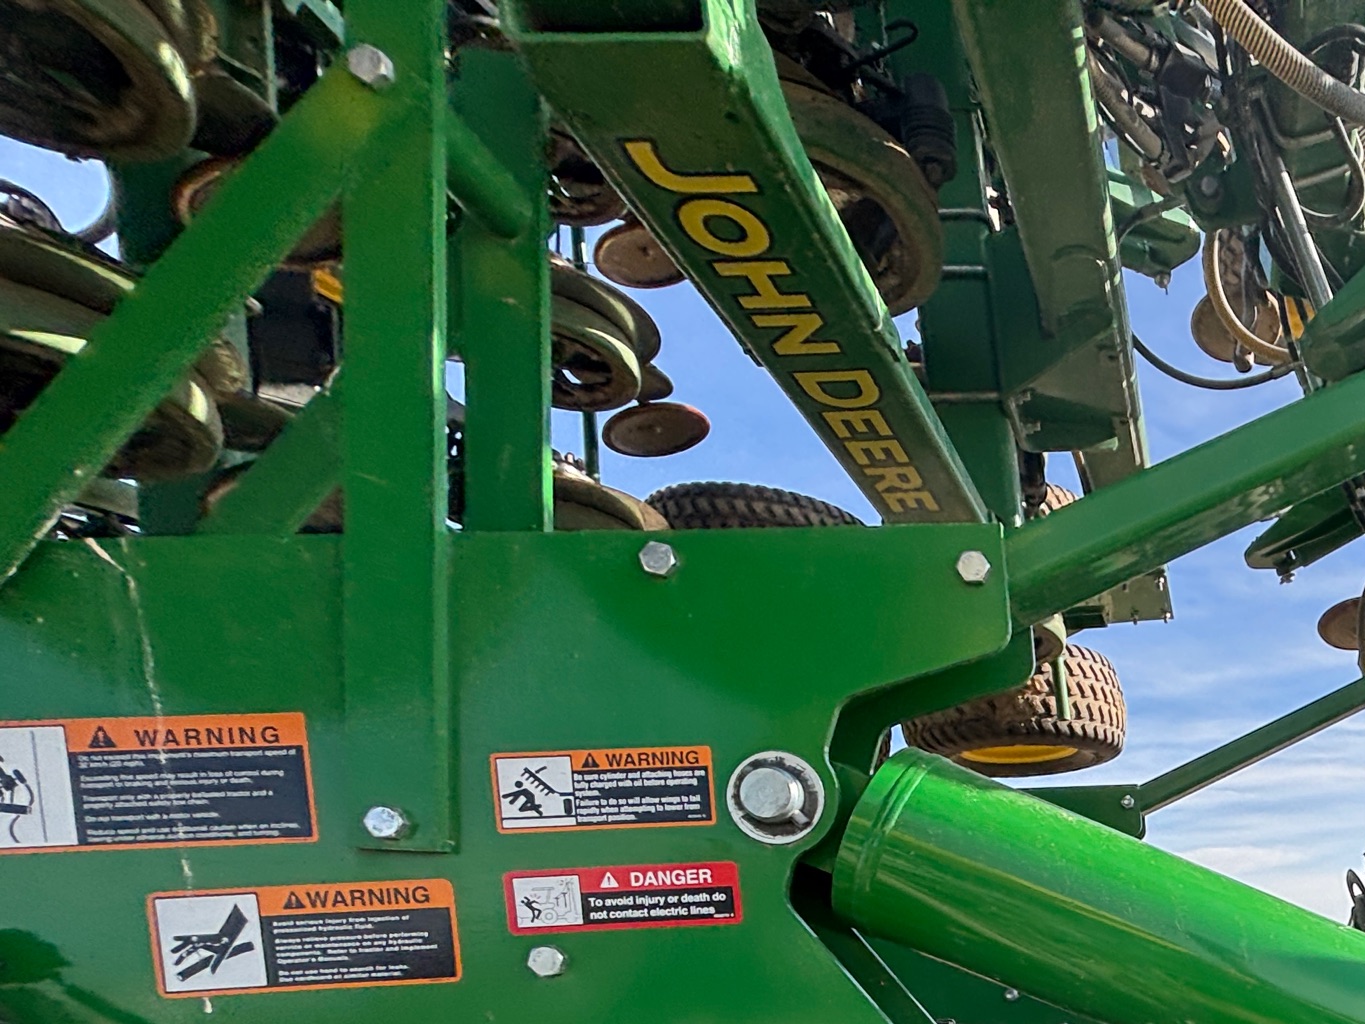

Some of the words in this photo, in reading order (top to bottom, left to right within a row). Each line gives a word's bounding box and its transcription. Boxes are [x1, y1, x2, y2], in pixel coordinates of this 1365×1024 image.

[624, 141, 841, 355] JOHN
[792, 370, 940, 513] DEERE
[134, 726, 281, 747] WARNING
[605, 751, 699, 767] WARNING
[630, 869, 712, 886] DANGER
[306, 886, 430, 908] WARNING
[588, 898, 602, 907] To
[605, 896, 633, 906] avoid
[635, 895, 665, 906] injury
[668, 895, 679, 903] or
[681, 892, 710, 903] death
[712, 892, 726, 901] do
[590, 910, 607, 919] not
[609, 908, 648, 918] contact
[650, 907, 688, 917] electric
[690, 906, 715, 914] lines
